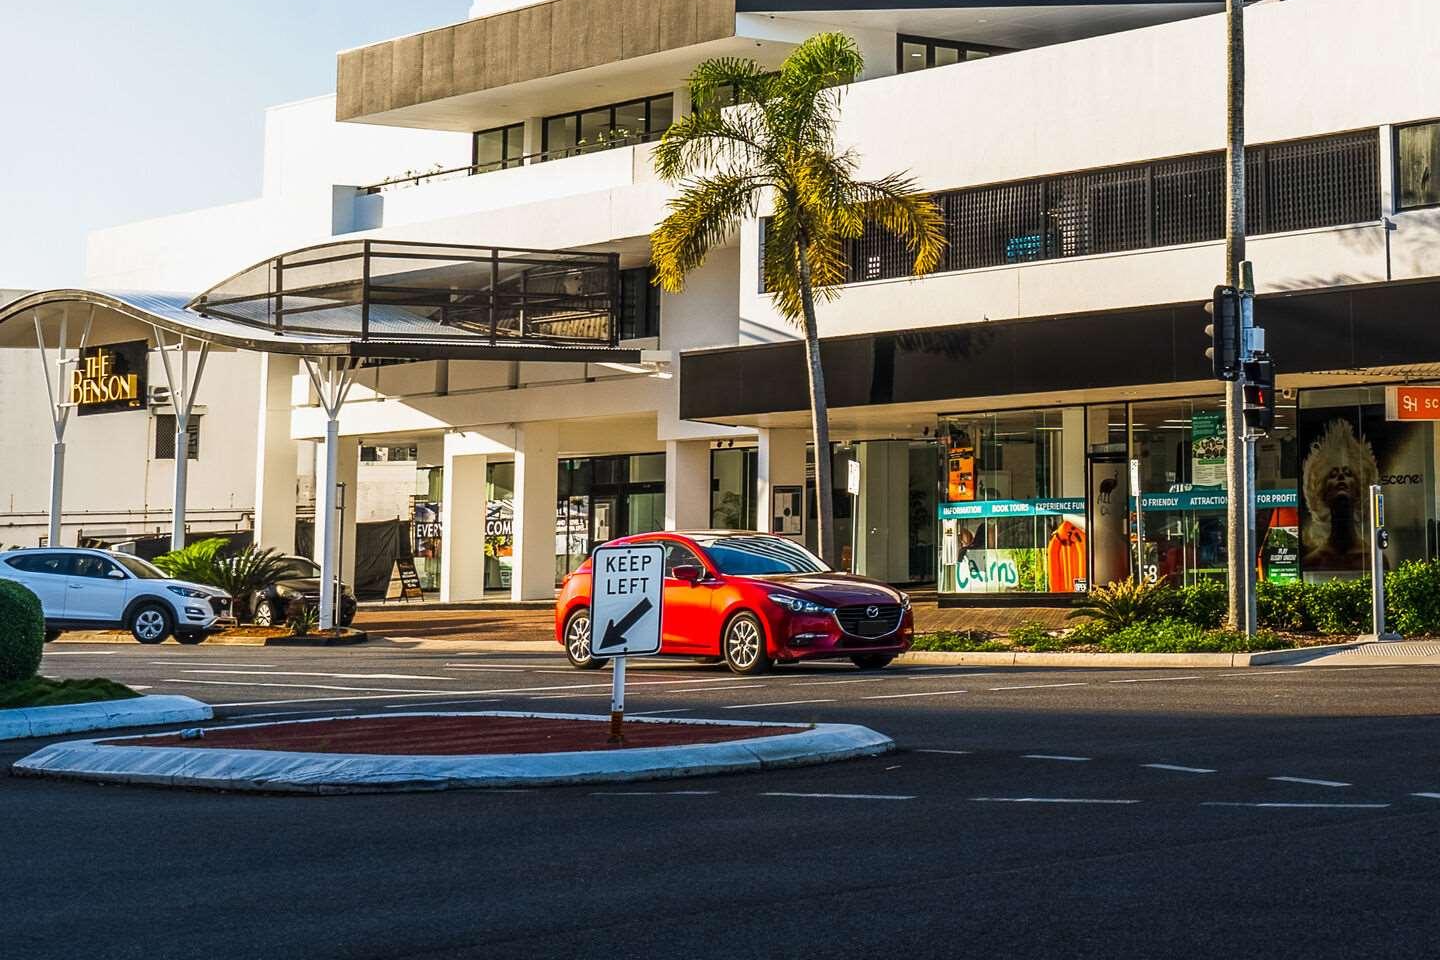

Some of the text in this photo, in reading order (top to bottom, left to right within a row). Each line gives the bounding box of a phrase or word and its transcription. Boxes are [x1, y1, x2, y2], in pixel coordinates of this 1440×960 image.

[84, 350, 109, 378] THE
[70, 369, 138, 405] BENSON
[1148, 498, 1179, 507] FRIENDLY
[1257, 493, 1297, 503] FOR PROFIT
[943, 506, 982, 515] INFORMATION
[991, 503, 1009, 513] BOOK
[1009, 503, 1029, 512] TOURS
[1035, 501, 1072, 511] EXPERIENCE
[606, 555, 652, 573] KEEP
[956, 559, 1016, 589] Cairns
[607, 577, 649, 594] LEFT
